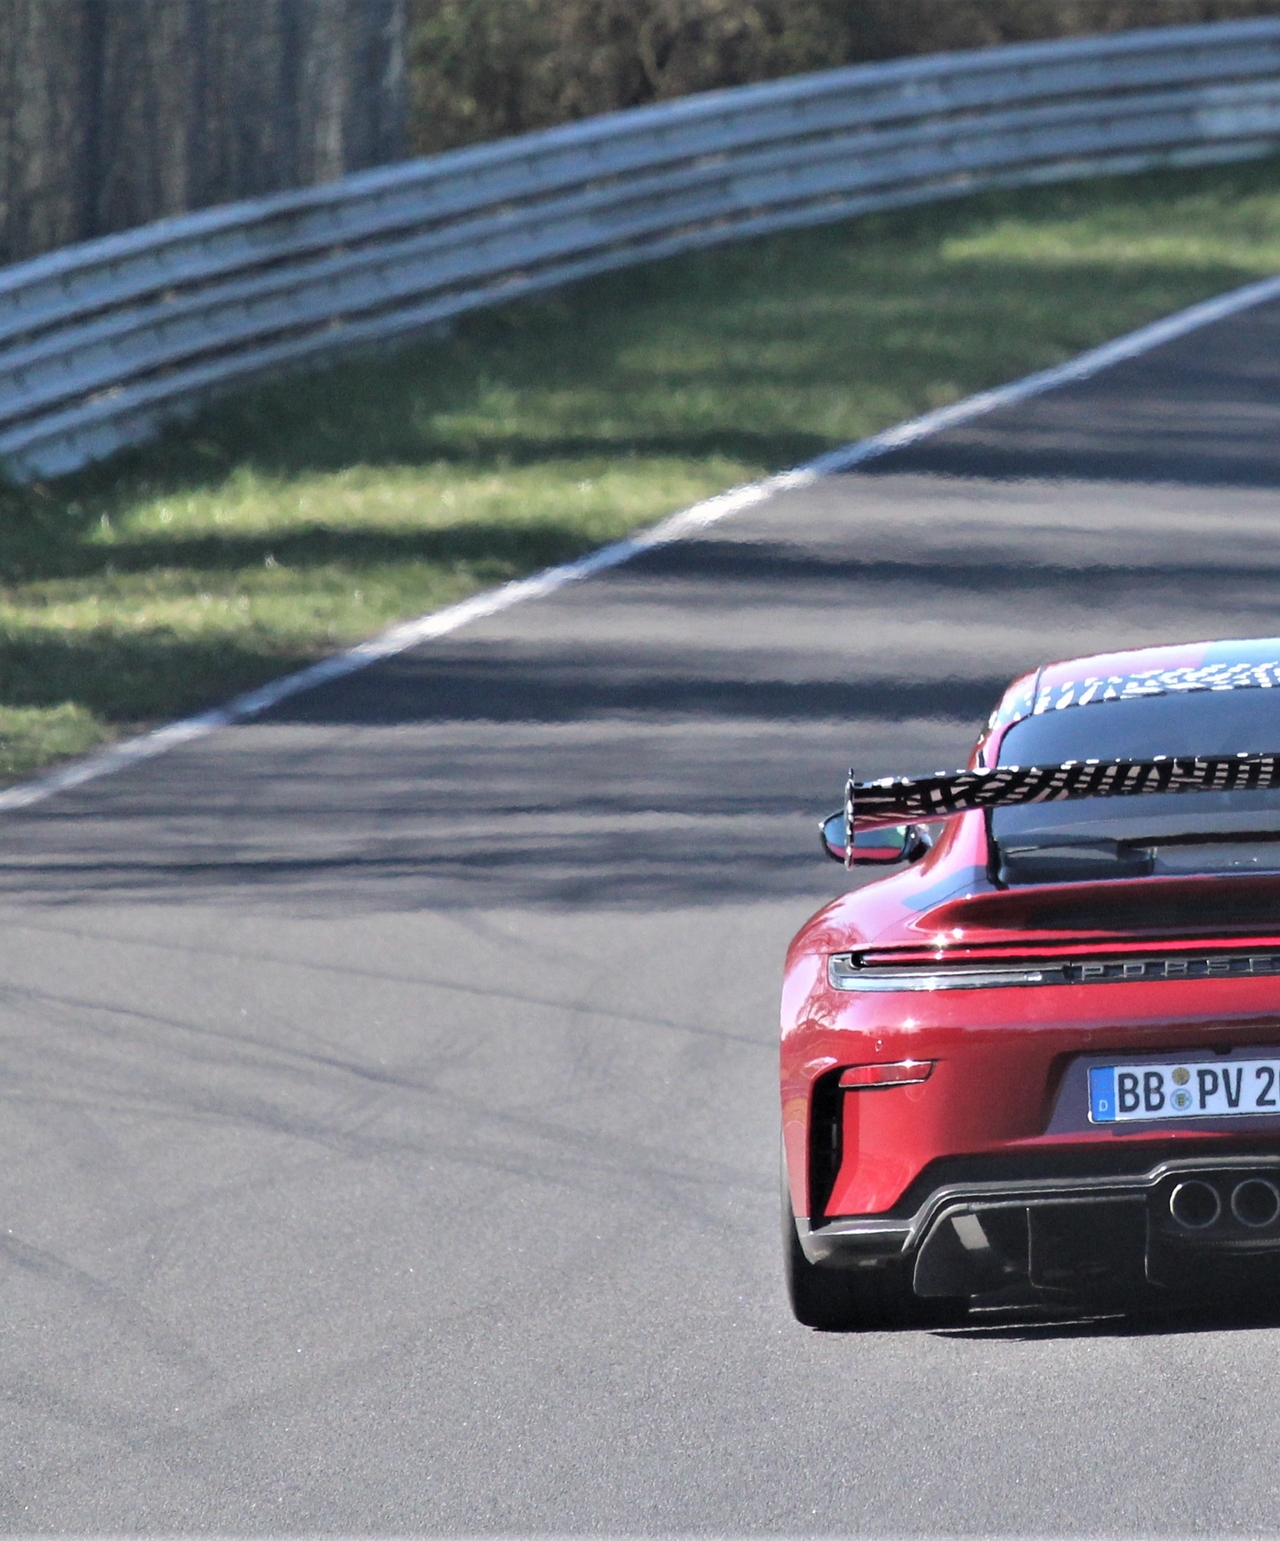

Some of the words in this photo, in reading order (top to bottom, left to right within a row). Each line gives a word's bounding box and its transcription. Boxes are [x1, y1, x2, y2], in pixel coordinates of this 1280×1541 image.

[1117, 1071, 1164, 1112] BB
[1197, 1068, 1243, 1109] PV
[1098, 1100, 1108, 1112] D
